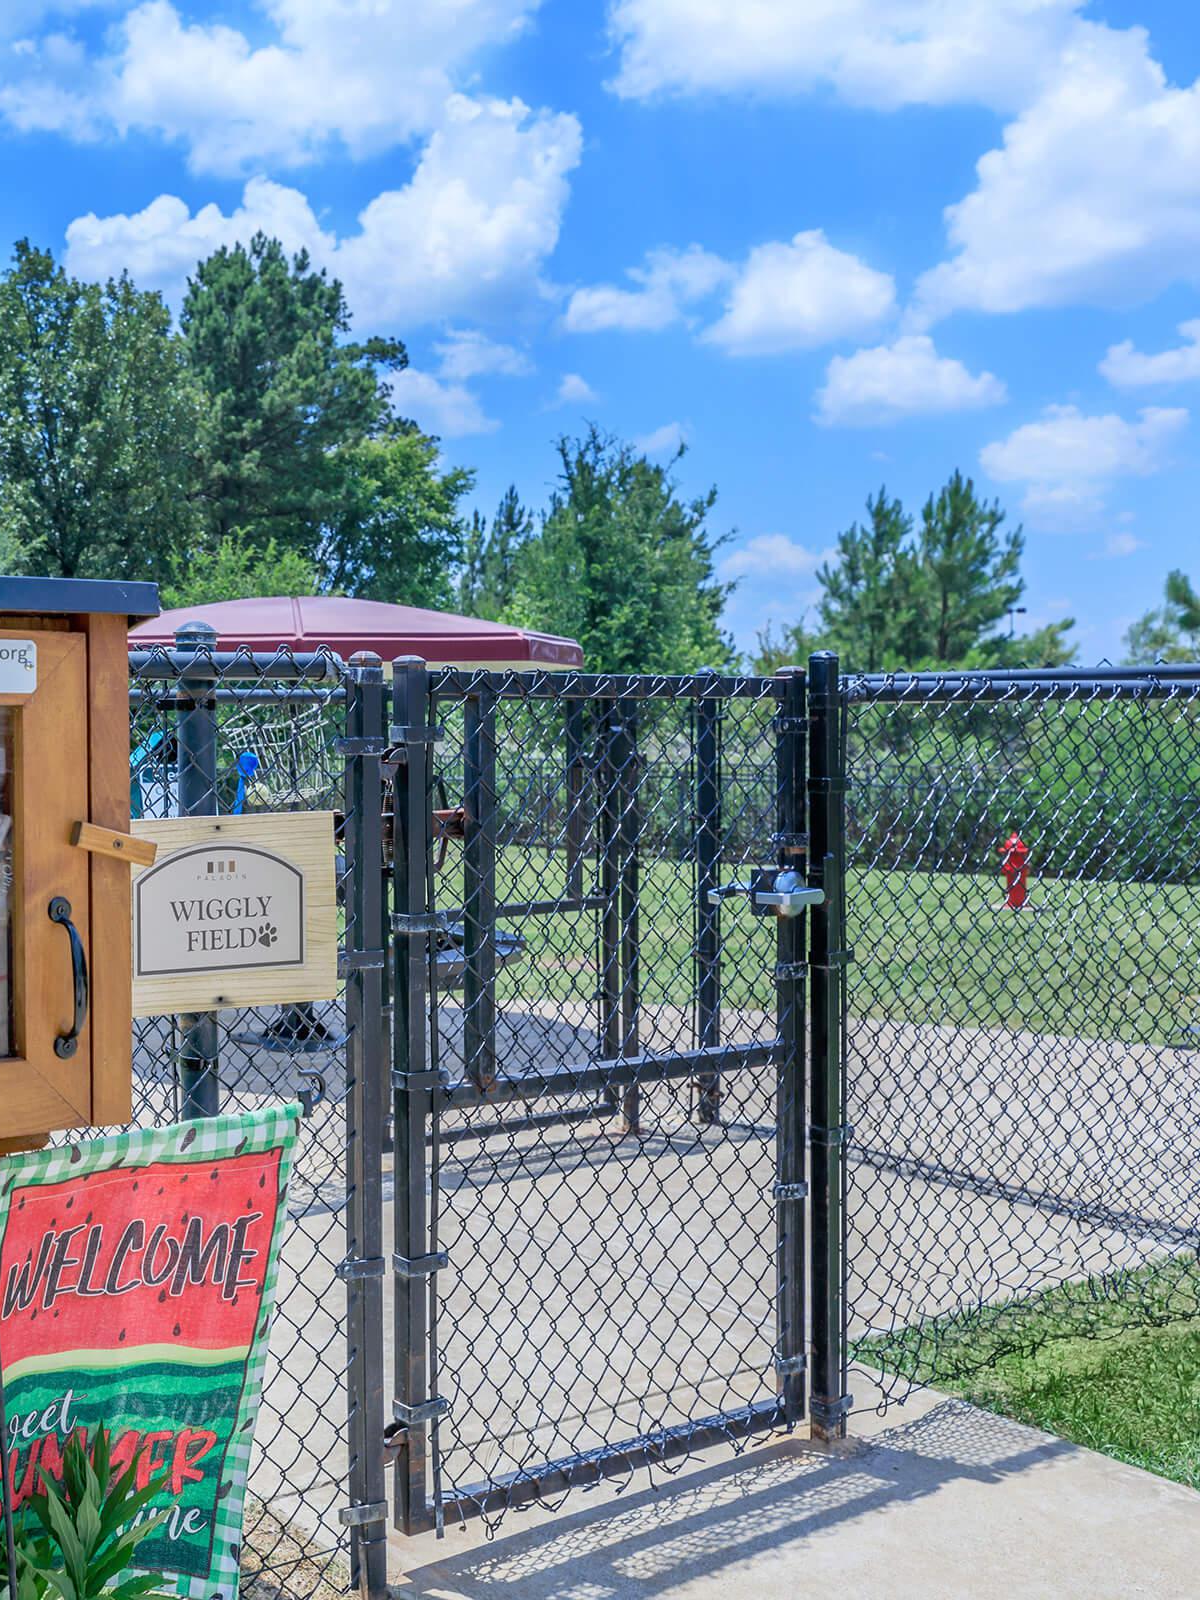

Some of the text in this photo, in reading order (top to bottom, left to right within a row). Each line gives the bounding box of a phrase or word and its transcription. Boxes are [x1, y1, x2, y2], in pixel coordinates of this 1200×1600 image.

[196, 873, 248, 881] PALADIN
[169, 895, 273, 922] WIGGLY
[186, 927, 257, 952] FIELD
[1, 1212, 263, 1320] WELCOME
[115, 1489, 208, 1541] ime
